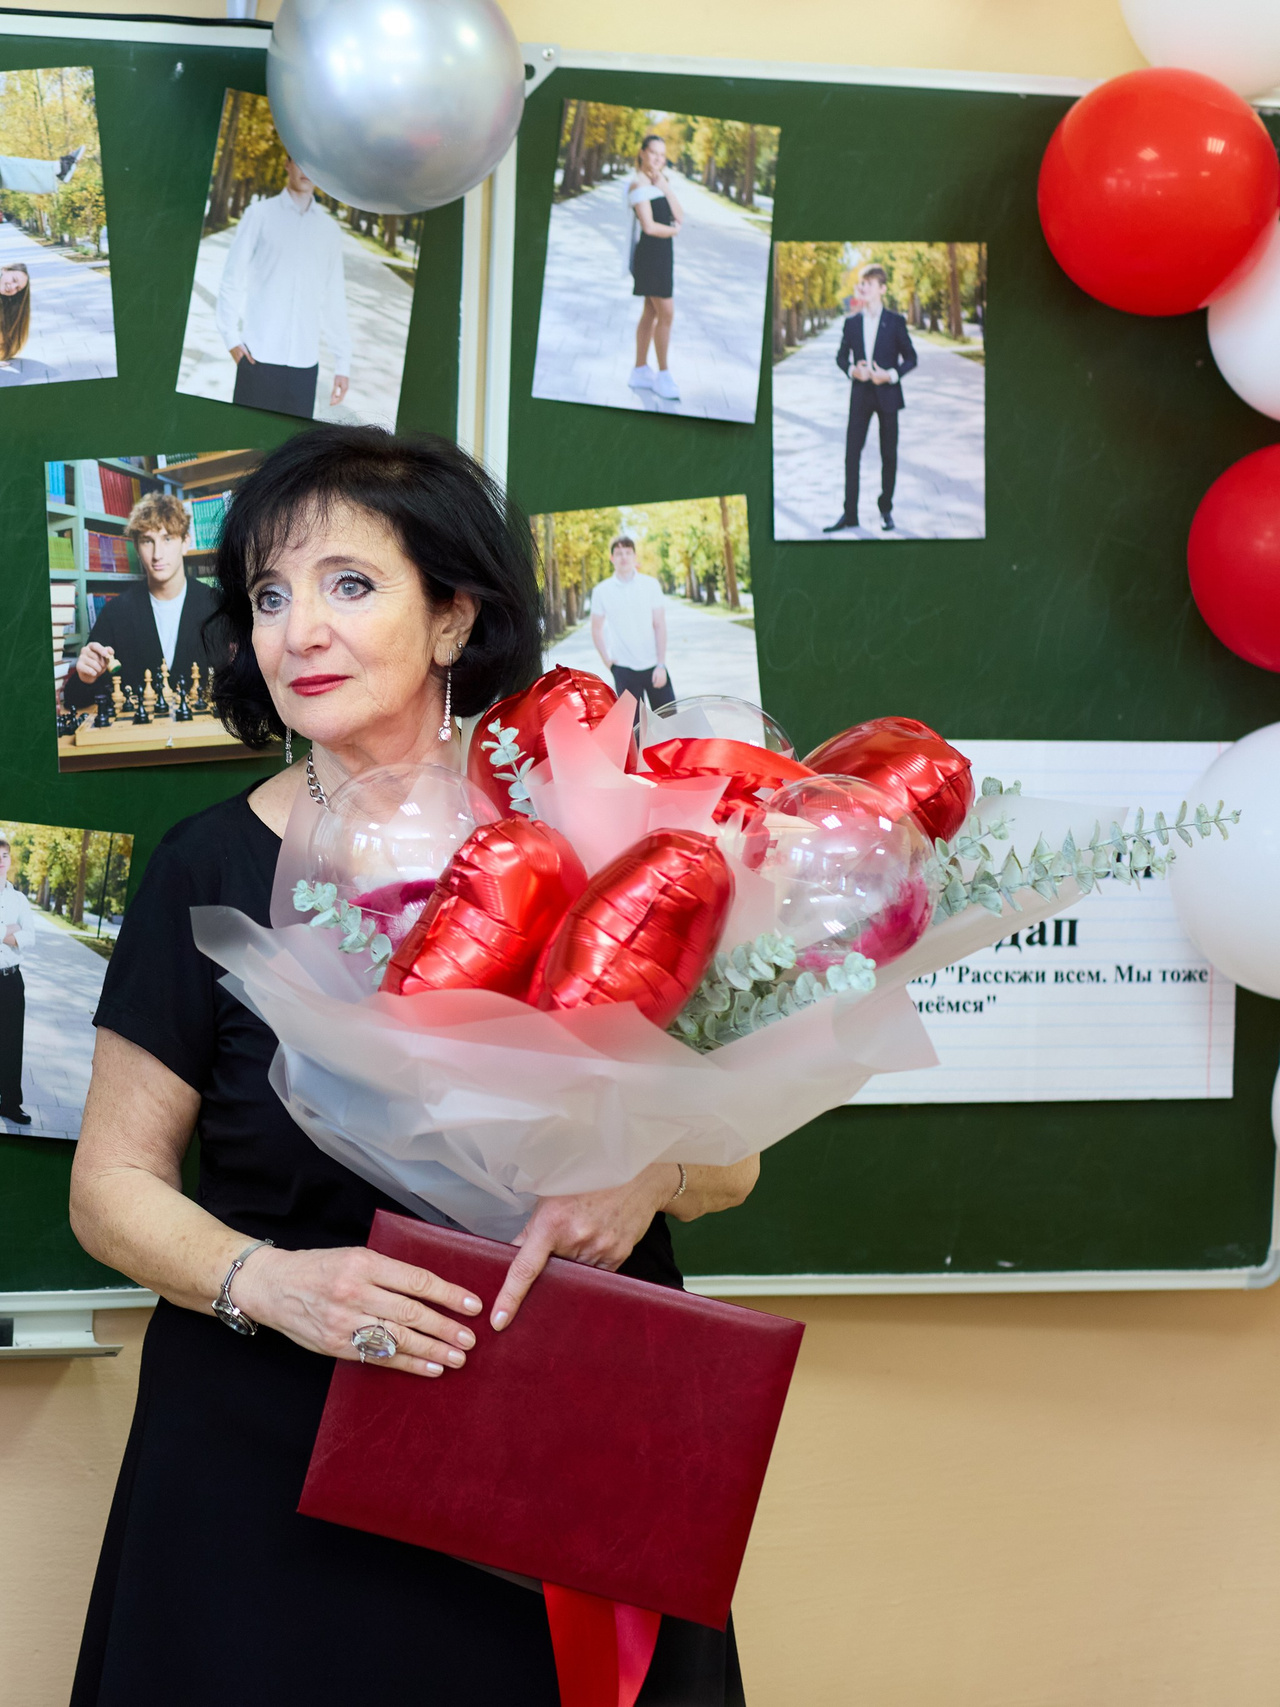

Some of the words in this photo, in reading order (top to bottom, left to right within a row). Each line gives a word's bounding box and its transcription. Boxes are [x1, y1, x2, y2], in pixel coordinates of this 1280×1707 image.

[945, 965, 1046, 984] "Расскжи
[1053, 968, 1107, 984] всем.
[1114, 964, 1152, 984] Мы
[1159, 968, 1209, 984] тоже
